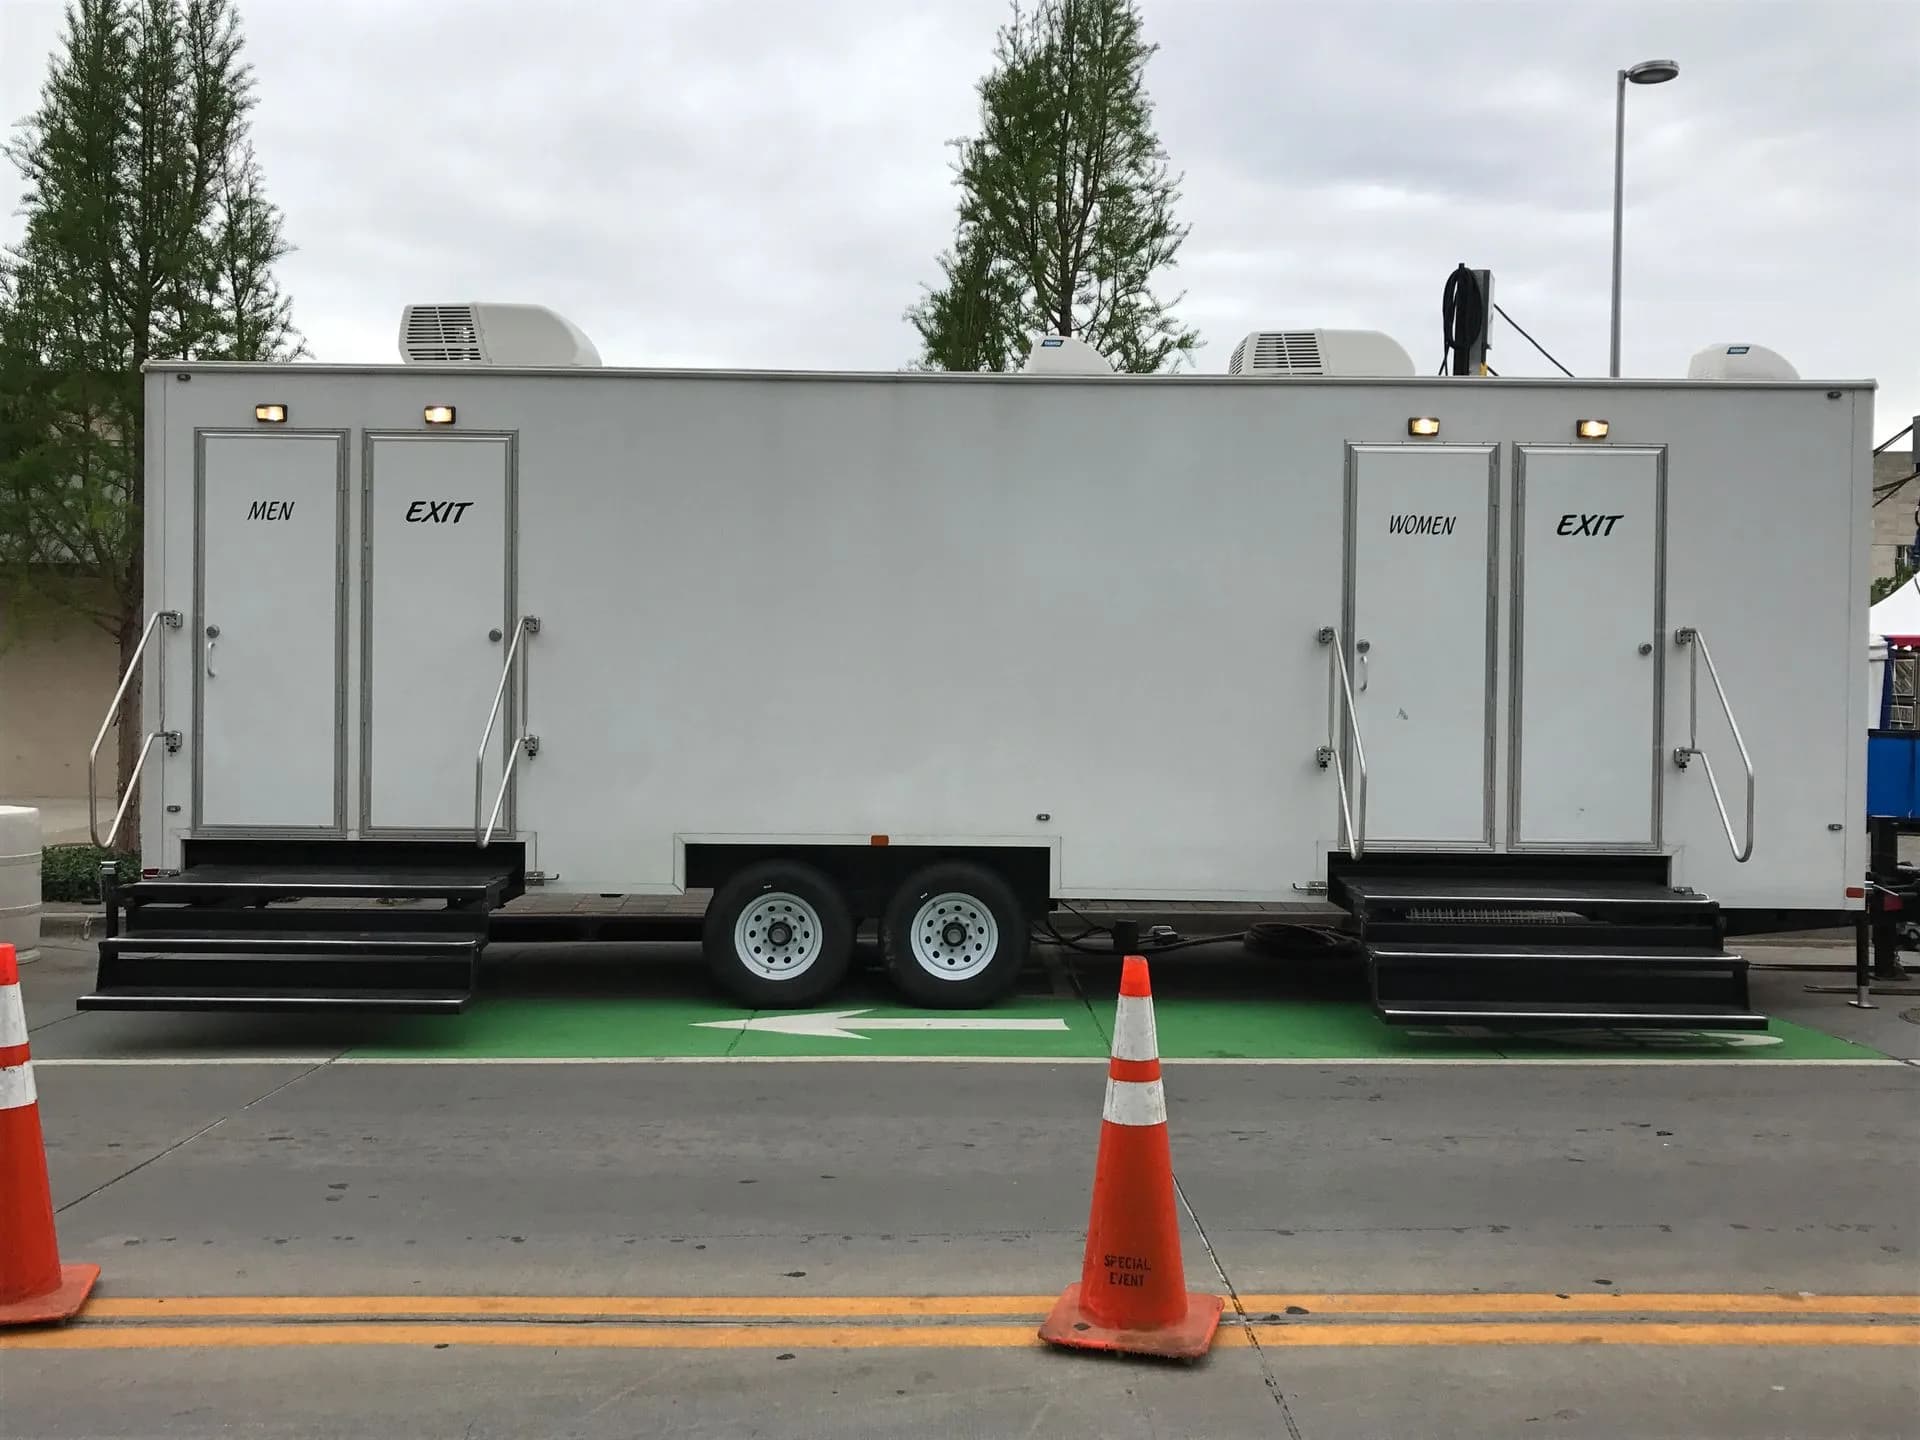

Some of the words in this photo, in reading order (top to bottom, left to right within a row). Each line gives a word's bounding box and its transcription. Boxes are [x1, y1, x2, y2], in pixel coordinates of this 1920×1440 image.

[247, 501, 295, 520] MEN
[405, 501, 474, 524] EXIT
[1389, 514, 1457, 536] WOMEN
[1556, 514, 1625, 537] EXIT
[1104, 1254, 1151, 1271] SPECIAL
[1110, 1271, 1144, 1287] EVENT
